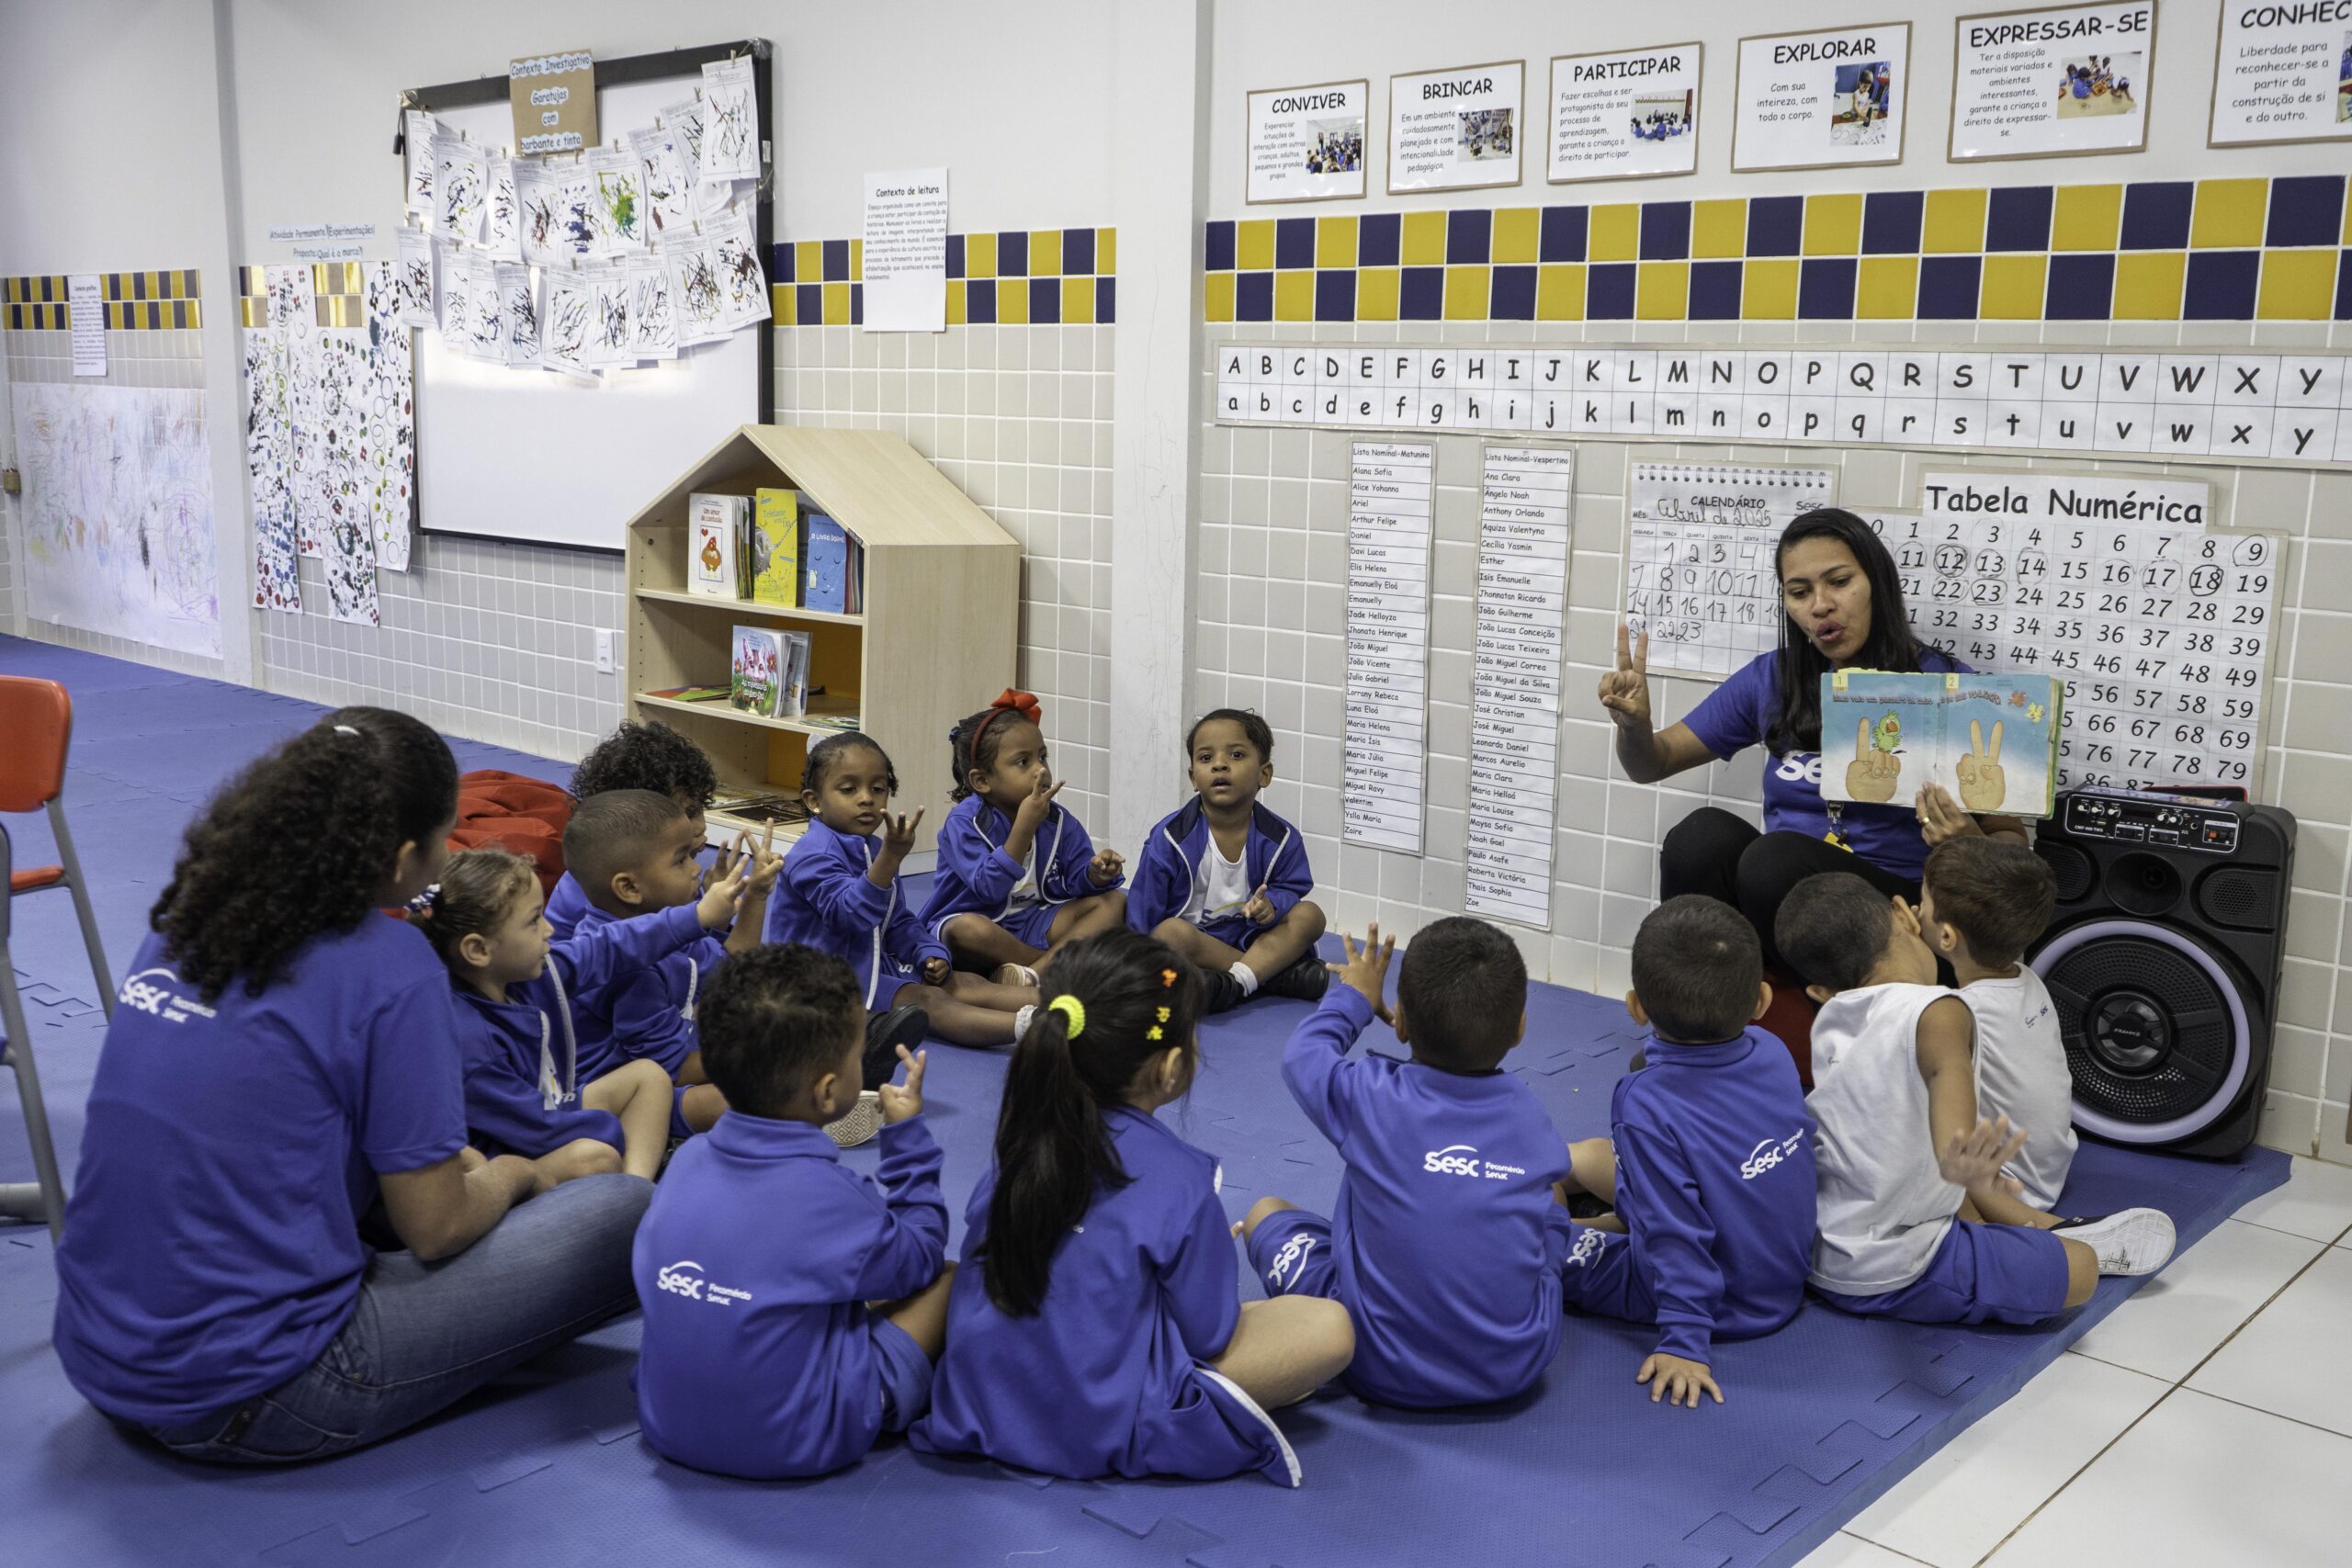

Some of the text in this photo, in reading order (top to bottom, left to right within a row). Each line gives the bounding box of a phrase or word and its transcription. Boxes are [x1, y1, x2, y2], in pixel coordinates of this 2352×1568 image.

[1971, 10, 2148, 48] EXPRESSAR-SE
[1773, 37, 1876, 64] EXPLORAR
[2004, 49, 2045, 60] disposição
[2240, 43, 2327, 58] Liberdade para
[511, 54, 590, 76] Contexto Investigativo
[1574, 55, 1680, 82] PARTICIPAR
[1971, 66, 2007, 75] materiais
[2010, 62, 2045, 71] variados
[2236, 61, 2318, 73] reconhecer-se
[1989, 76, 2030, 86] ambientes
[2255, 76, 2305, 92] partir da
[1423, 78, 1492, 99] BRINCAR
[1771, 84, 1789, 92] Com
[532, 89, 567, 104] Garatujas
[1272, 92, 1345, 113] CONVIVER
[1758, 98, 1798, 107] inteireza,
[2233, 92, 2325, 107] construção de si
[1970, 105, 2000, 116] garante
[2010, 102, 2039, 110] criança
[542, 113, 558, 125] com
[1758, 112, 1778, 121] todo
[1789, 112, 1814, 121] corpo.
[1964, 117, 1991, 126] direito
[2007, 114, 2051, 124] expressar-
[2256, 112, 2269, 122] do
[2274, 111, 2307, 121] outro.
[564, 135, 582, 146] tinta
[876, 186, 939, 197] Contexto de leitura
[1228, 355, 2322, 395] A B C D E F G H I J K L M N O P Q R S T U V W X Y
[1352, 447, 1369, 457] Lista
[1691, 495, 1765, 509] CALENDÁRIO
[1927, 486, 2201, 524] Tabela Numérica
[1377, 517, 1396, 526] Felipe
[1633, 511, 1649, 519] MÊS:
[1713, 511, 1727, 525] de
[1733, 507, 1771, 527] 2025
[1351, 532, 1371, 540] Daniel
[1909, 522, 2263, 562] 1 2 3 4 5 6 7 8 9
[1480, 556, 1505, 565] Esther
[1479, 573, 1531, 584] Isis Emanuelle
[1657, 593, 1755, 624] 15 16 17 18
[2099, 594, 2264, 625] 26 27 28 29
[1950, 677, 1955, 686] 2
[2092, 684, 2253, 718] 56 57 58 59
[1473, 738, 1529, 752] Leonardo Daniel
[1473, 753, 1525, 768] Marcos Aurelio
[1345, 827, 1363, 836] Zaire
[1466, 898, 1479, 907] Zoe
